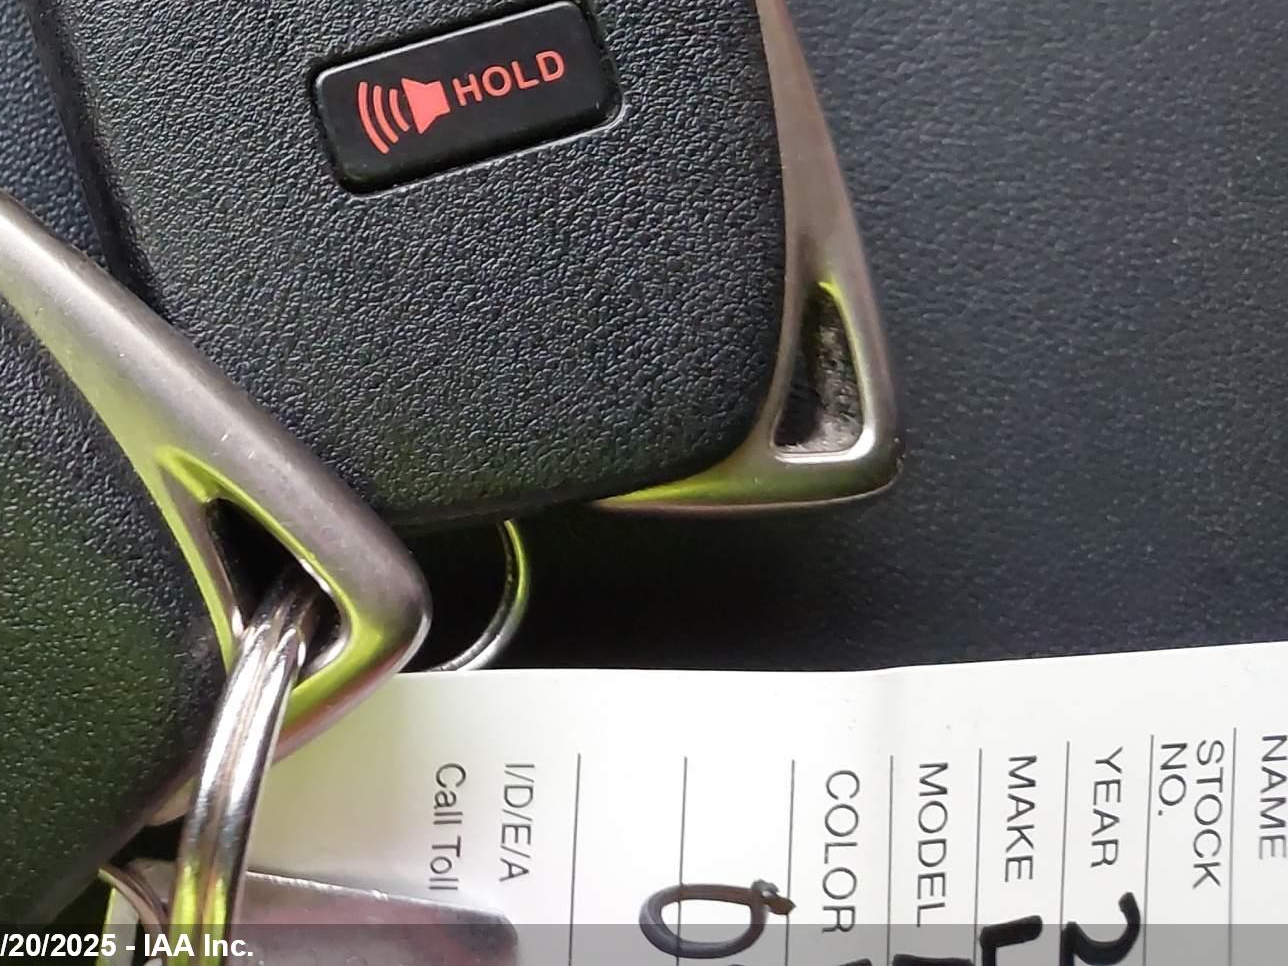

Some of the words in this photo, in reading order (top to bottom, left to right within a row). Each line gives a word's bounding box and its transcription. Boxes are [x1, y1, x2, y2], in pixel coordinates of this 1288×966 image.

[451, 50, 566, 106] HOLD
[432, 762, 467, 825] Call
[498, 762, 536, 882] I/D/E/A
[1005, 755, 1038, 883] MAKE
[1091, 746, 1124, 868] YEAR
[1158, 742, 1188, 817] NO.
[1192, 739, 1225, 889] STOCK
[1258, 735, 1288, 860] NAME
[429, 836, 460, 891] Toll
[822, 770, 860, 933] COLOR
[916, 762, 949, 927] MODEL
